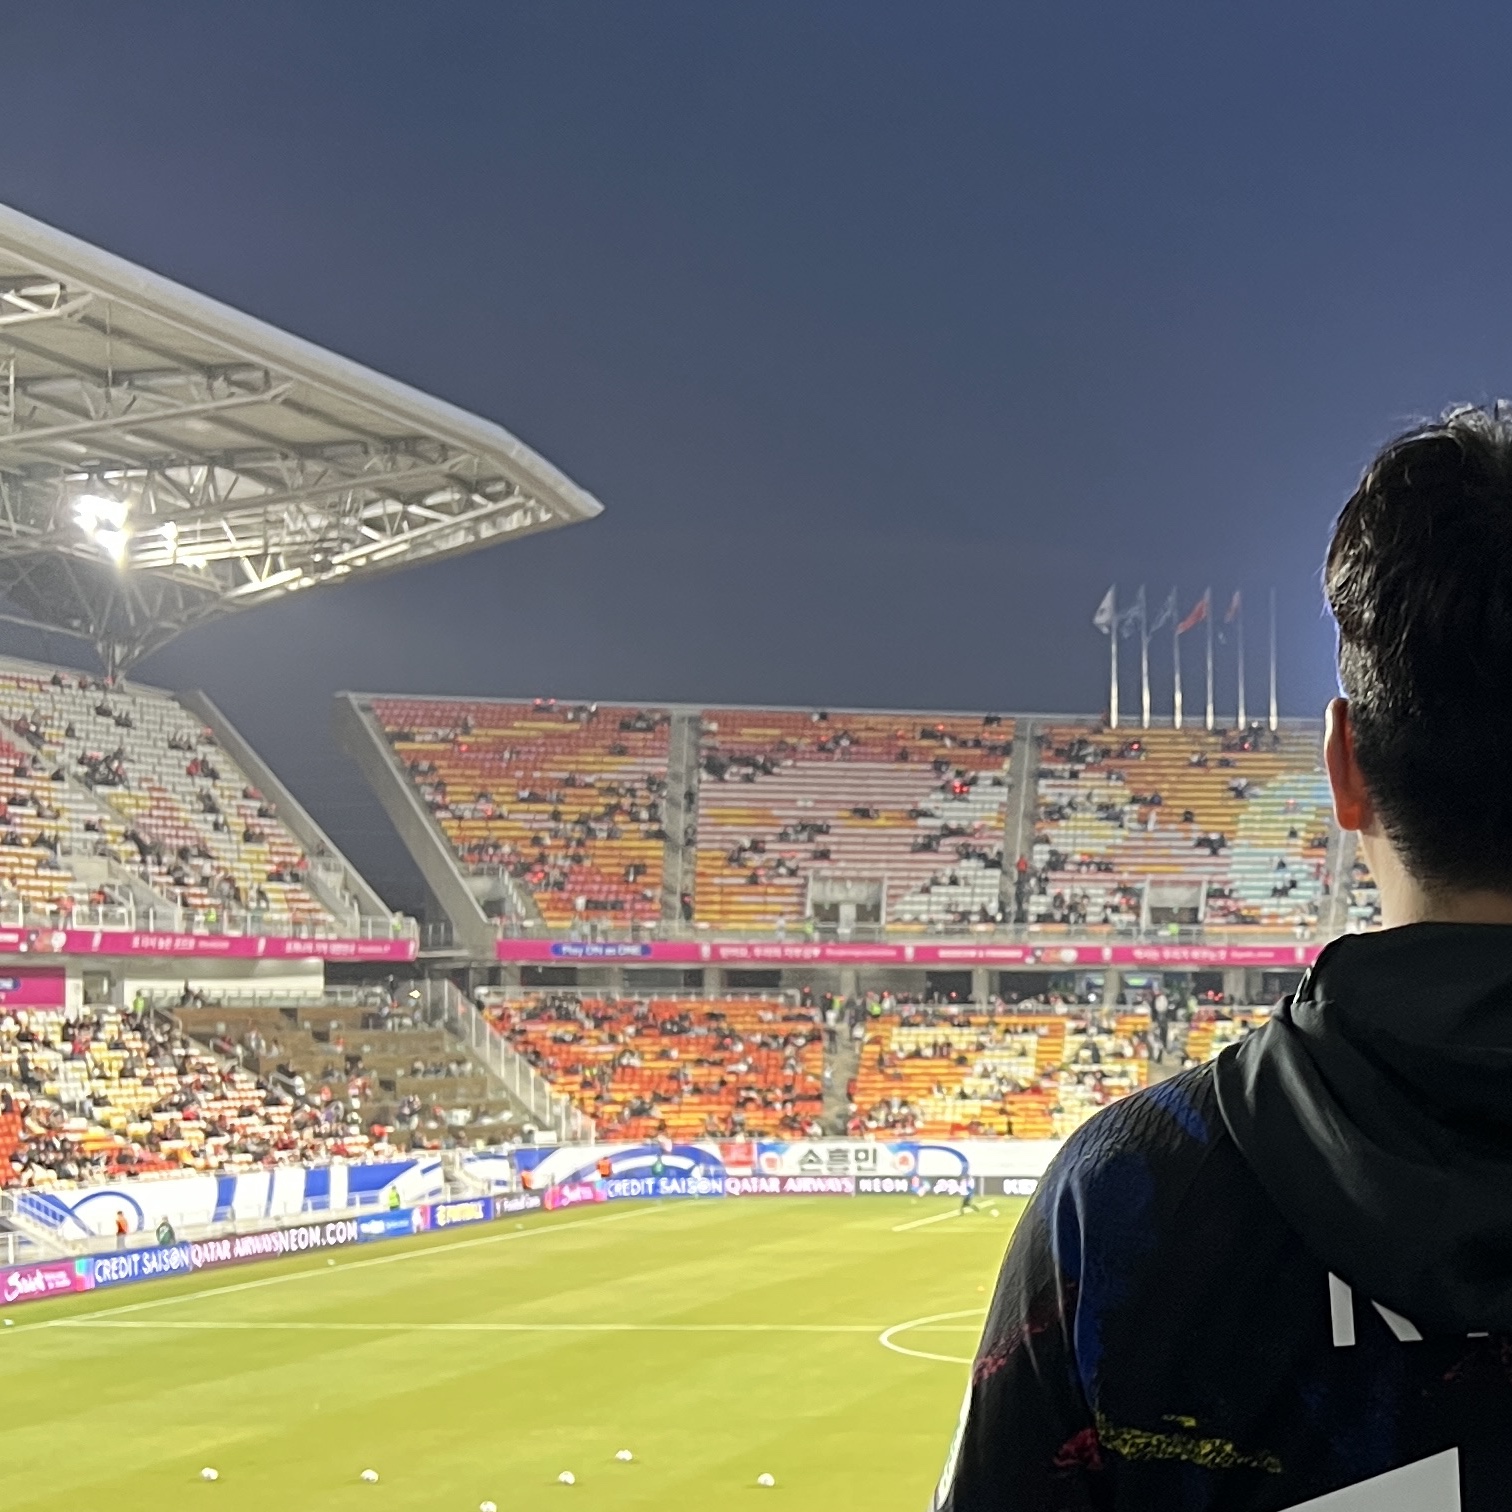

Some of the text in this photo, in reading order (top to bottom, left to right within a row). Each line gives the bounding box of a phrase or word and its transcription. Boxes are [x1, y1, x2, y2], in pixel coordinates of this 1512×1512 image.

[800, 1148, 878, 1173] 손흥민
[607, 1178, 656, 1197] CREDIT
[658, 1176, 723, 1194] SAISON
[725, 1176, 855, 1195] QATAR AIRWAYS
[858, 1177, 909, 1193] NEOM
[278, 1220, 359, 1253] NEOM.COM
[94, 1253, 140, 1284] CREDIT
[142, 1246, 191, 1275] SAISON
[191, 1239, 232, 1268] QATAR
